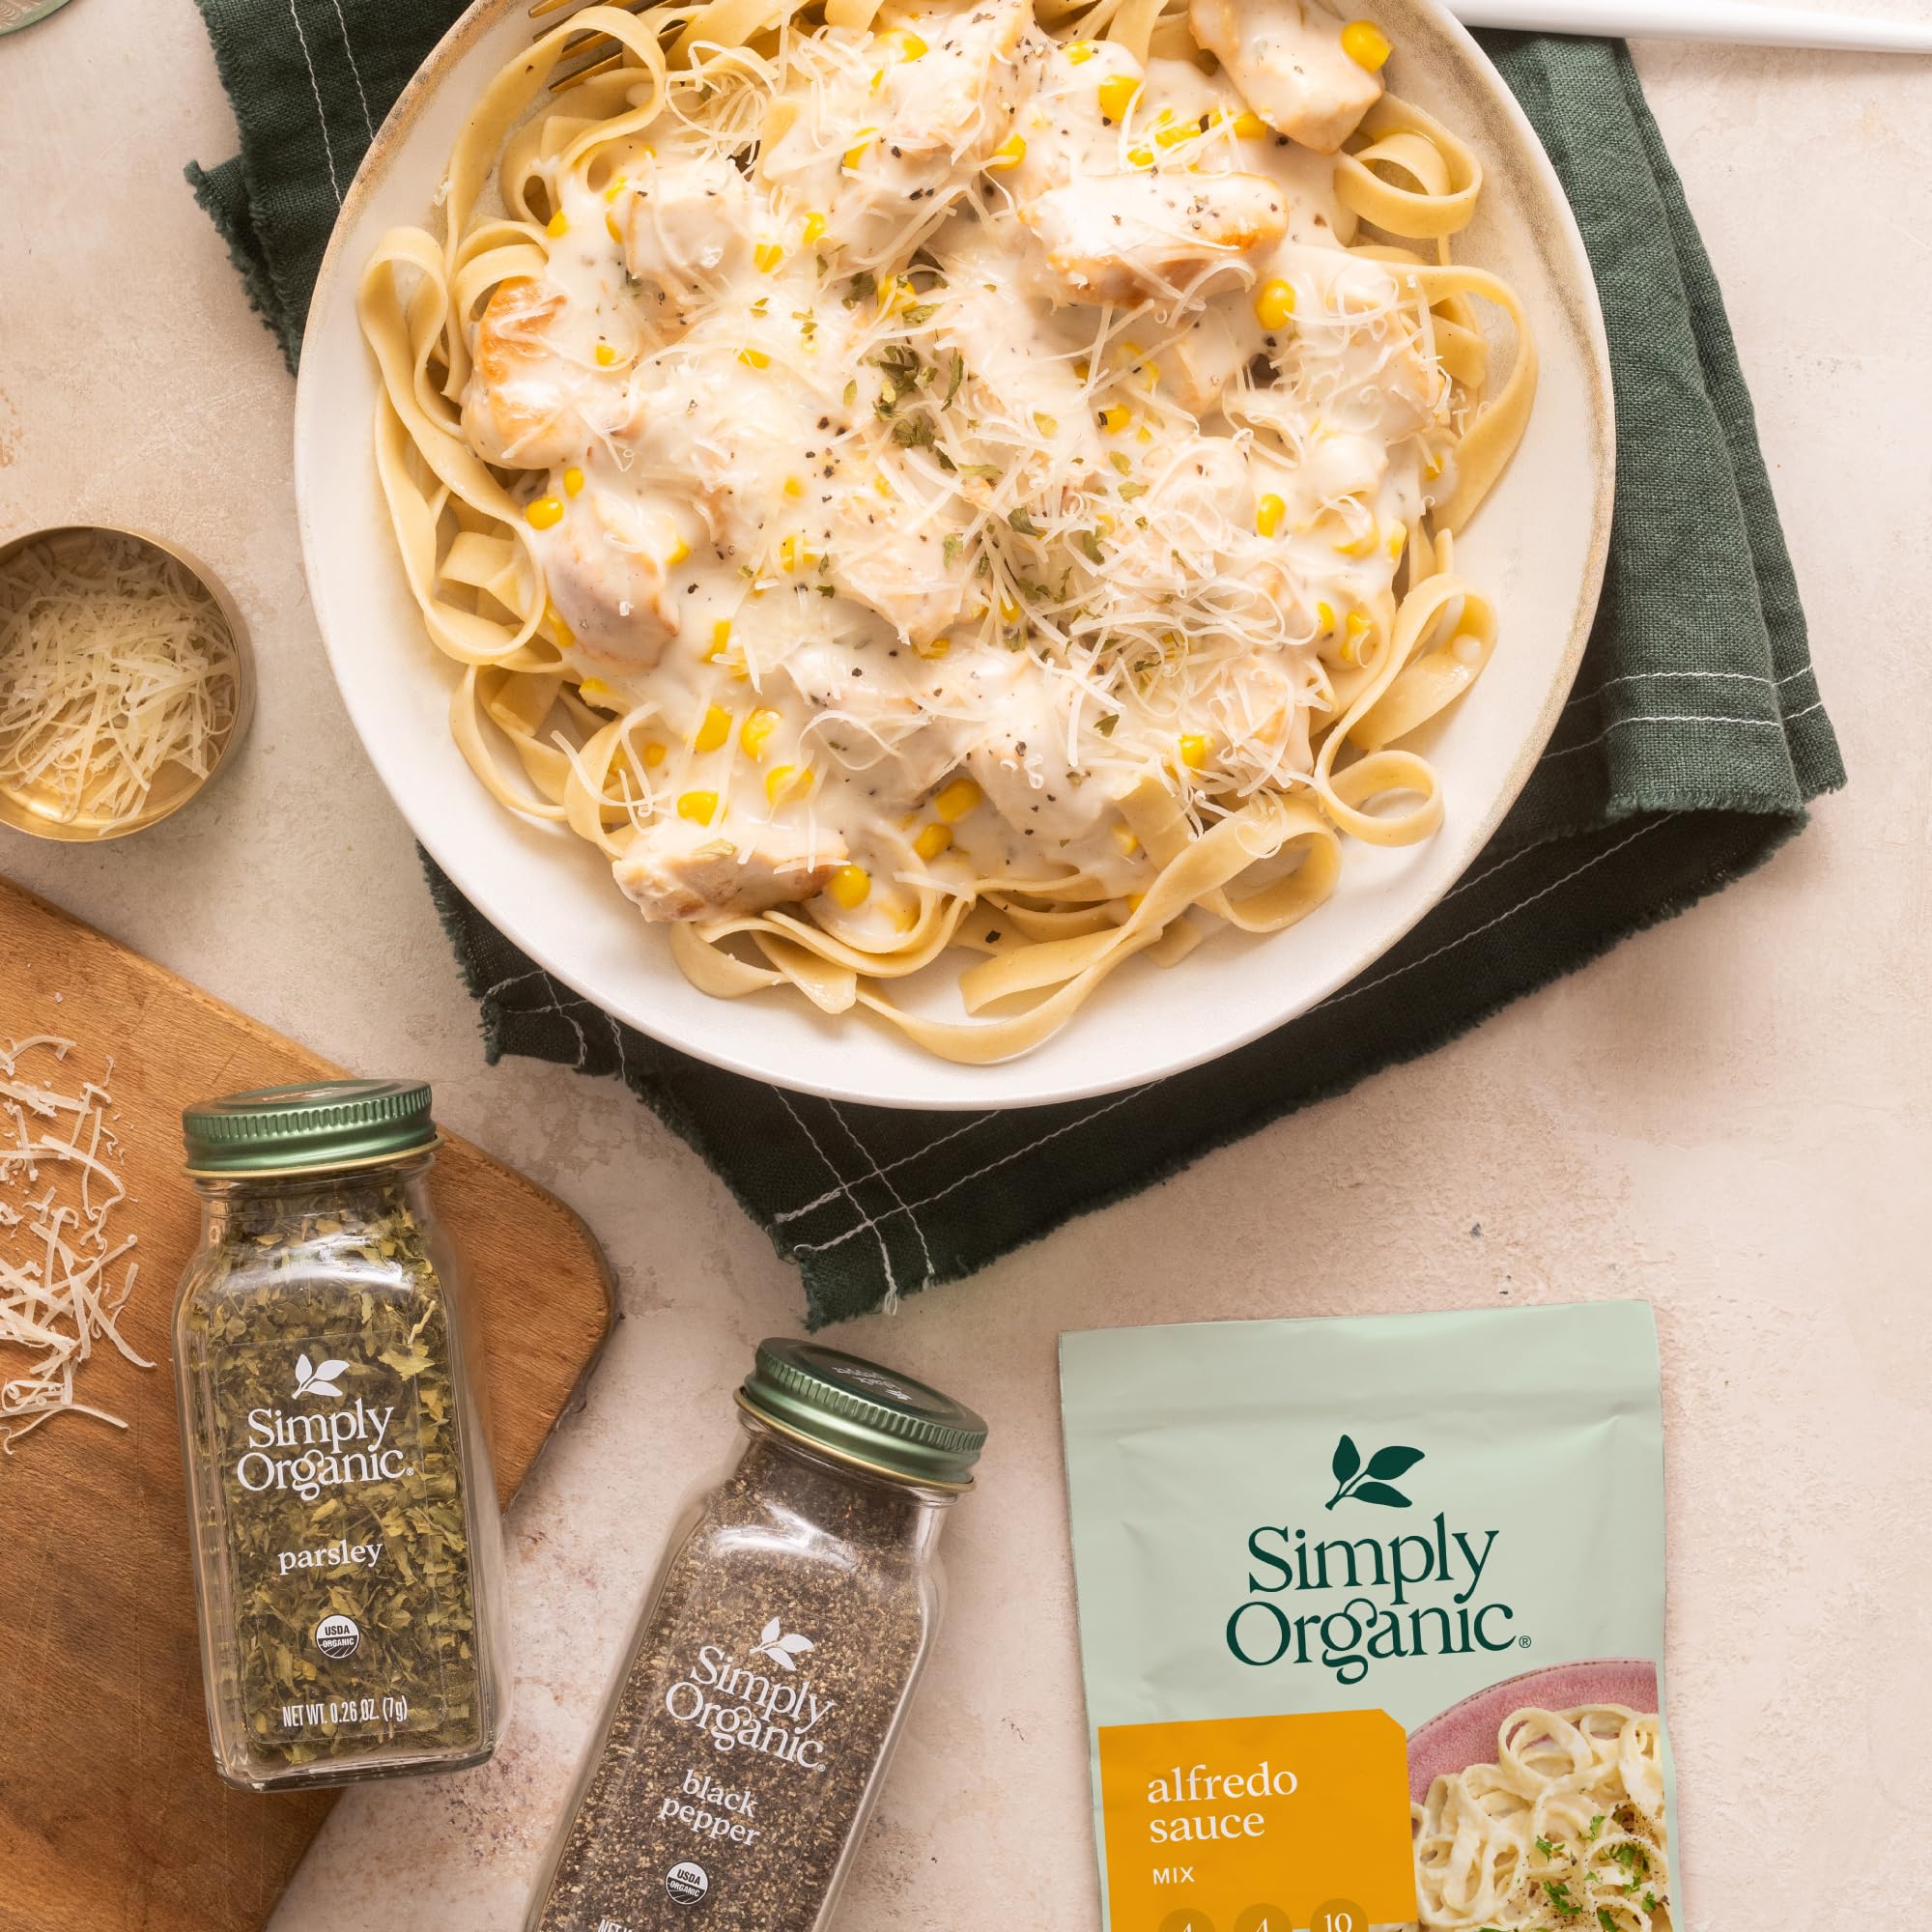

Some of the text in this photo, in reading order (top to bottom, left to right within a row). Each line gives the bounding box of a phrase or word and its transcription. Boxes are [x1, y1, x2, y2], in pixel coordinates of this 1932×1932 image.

[248, 1398, 394, 1454] Simply
[278, 1539, 384, 1576] parsley
[1248, 1512, 1499, 1605] Simply
[322, 1637, 355, 1648] ORGANIC
[325, 1625, 351, 1636] USDA
[690, 1645, 838, 1734] Simply
[282, 1705, 304, 1727] NET
[305, 1703, 327, 1725] WT.
[329, 1700, 357, 1723] 0.26
[382, 1694, 408, 1722] (7g)
[682, 1769, 758, 1818] black
[1148, 1761, 1298, 1804] alfredo
[658, 1798, 761, 1846] pepper
[1150, 1812, 1265, 1844] sauce
[669, 1880, 700, 1897] ORGANIC
[676, 1868, 701, 1886] USDA
[1152, 1865, 1196, 1885] MIX
[1323, 1913, 1353, 1932] 10
